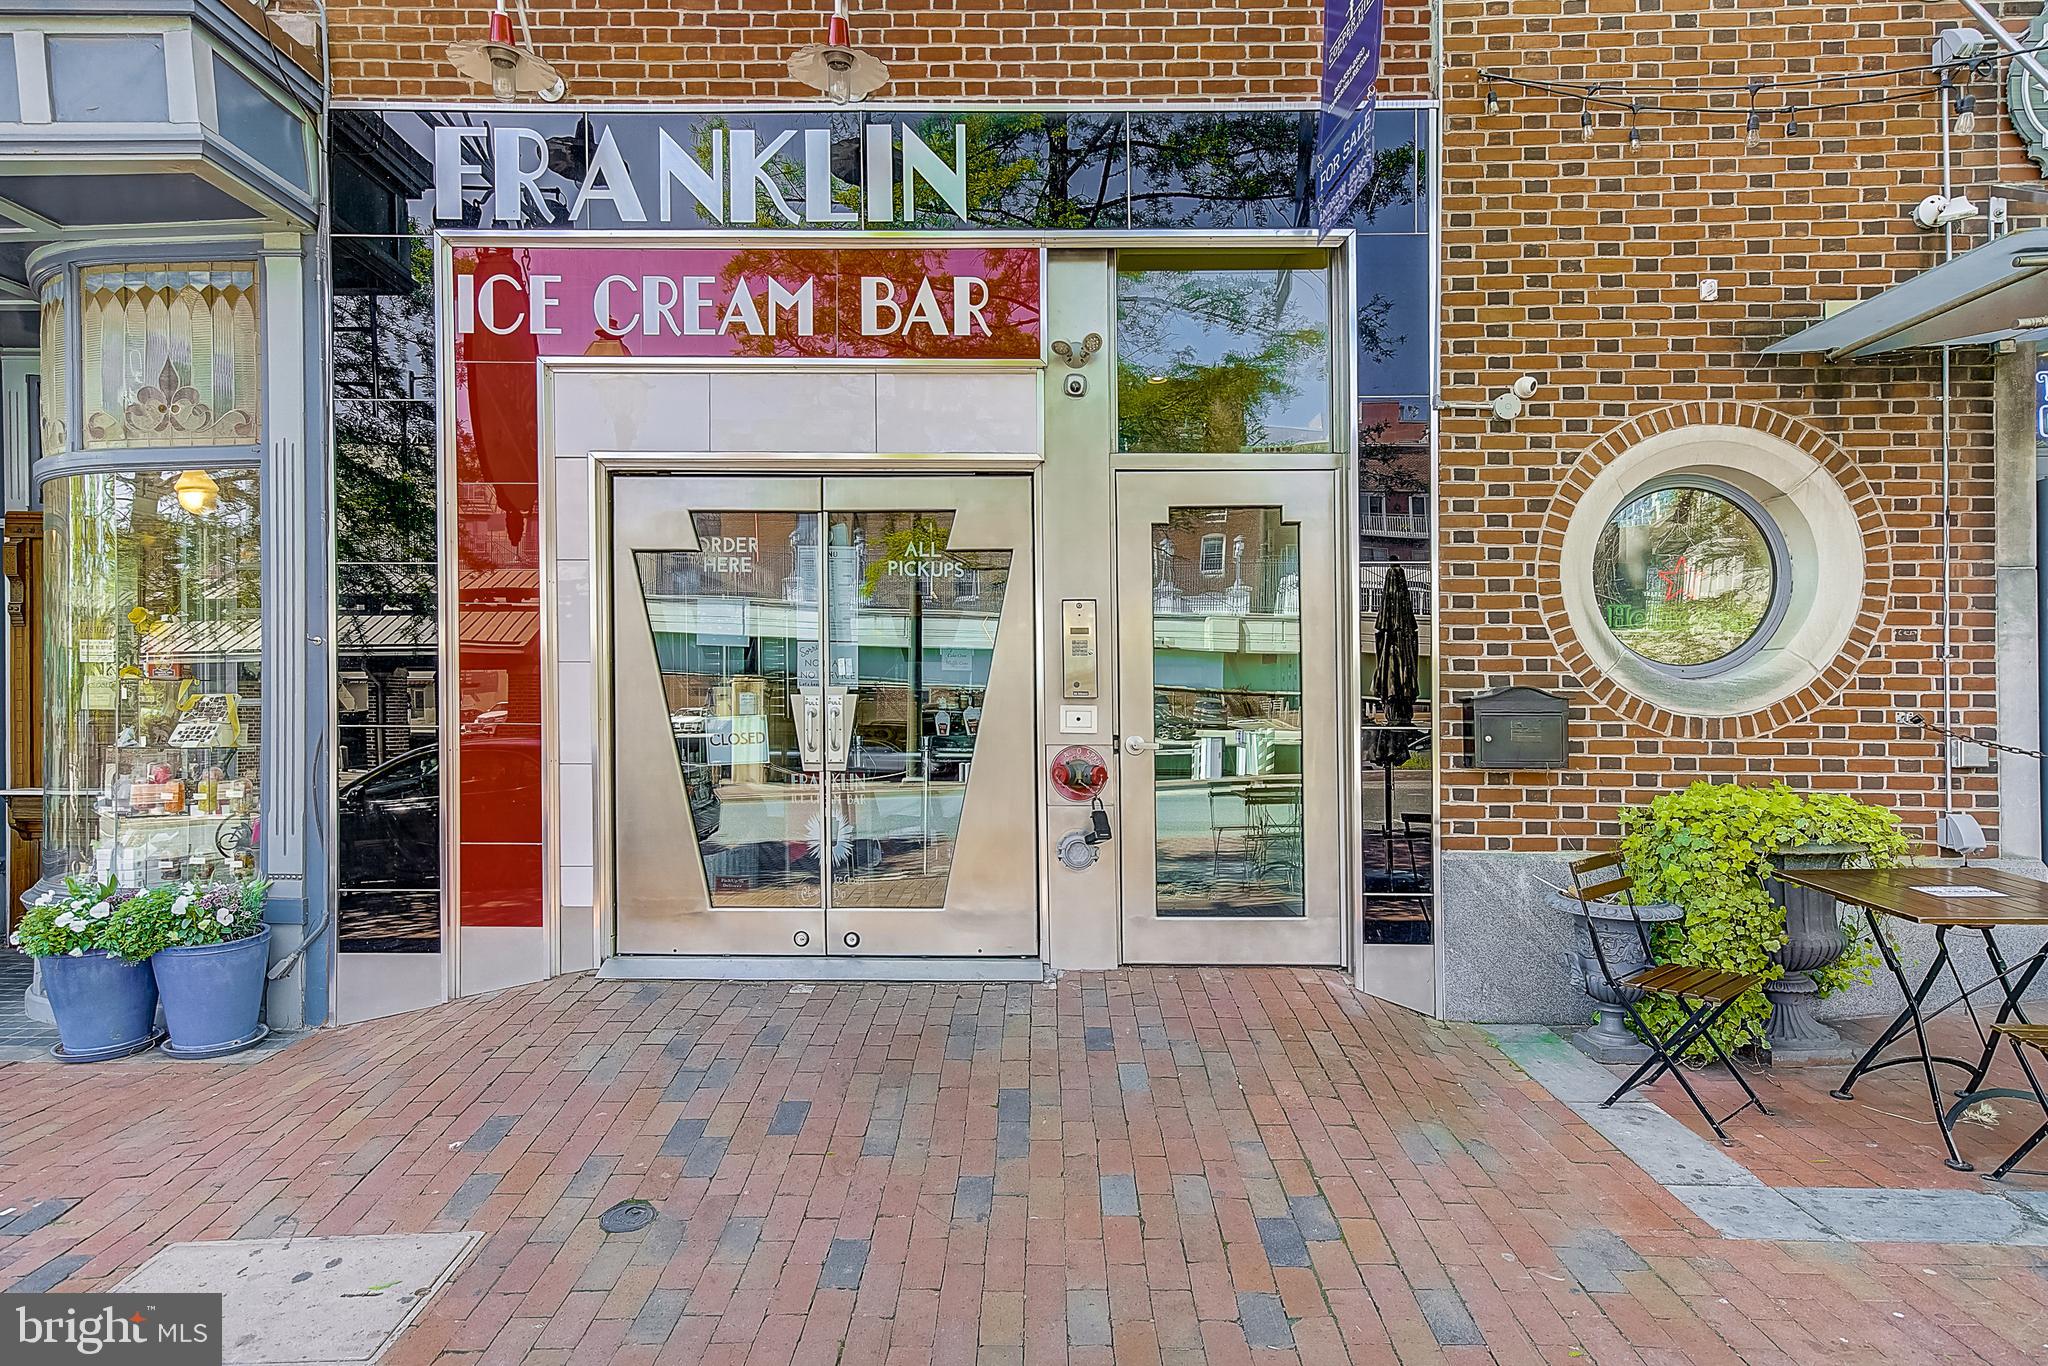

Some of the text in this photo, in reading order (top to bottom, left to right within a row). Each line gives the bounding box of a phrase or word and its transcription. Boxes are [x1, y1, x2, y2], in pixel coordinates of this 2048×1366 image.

[1328, 17, 1357, 64] COPPER
[1319, 152, 1341, 192] FOR
[1342, 108, 1372, 161] SALE
[433, 123, 968, 226] FRANKLIN
[456, 274, 993, 338] ICE CREAM BAR
[698, 536, 758, 553] ORDER
[904, 540, 942, 558] ALL
[703, 556, 753, 574] HERE
[888, 560, 966, 578] PICKUPS
[800, 671, 816, 679] NO
[709, 731, 766, 747] CLOSED
[790, 772, 867, 791] FRAKLIN
[847, 794, 867, 805] BAR
